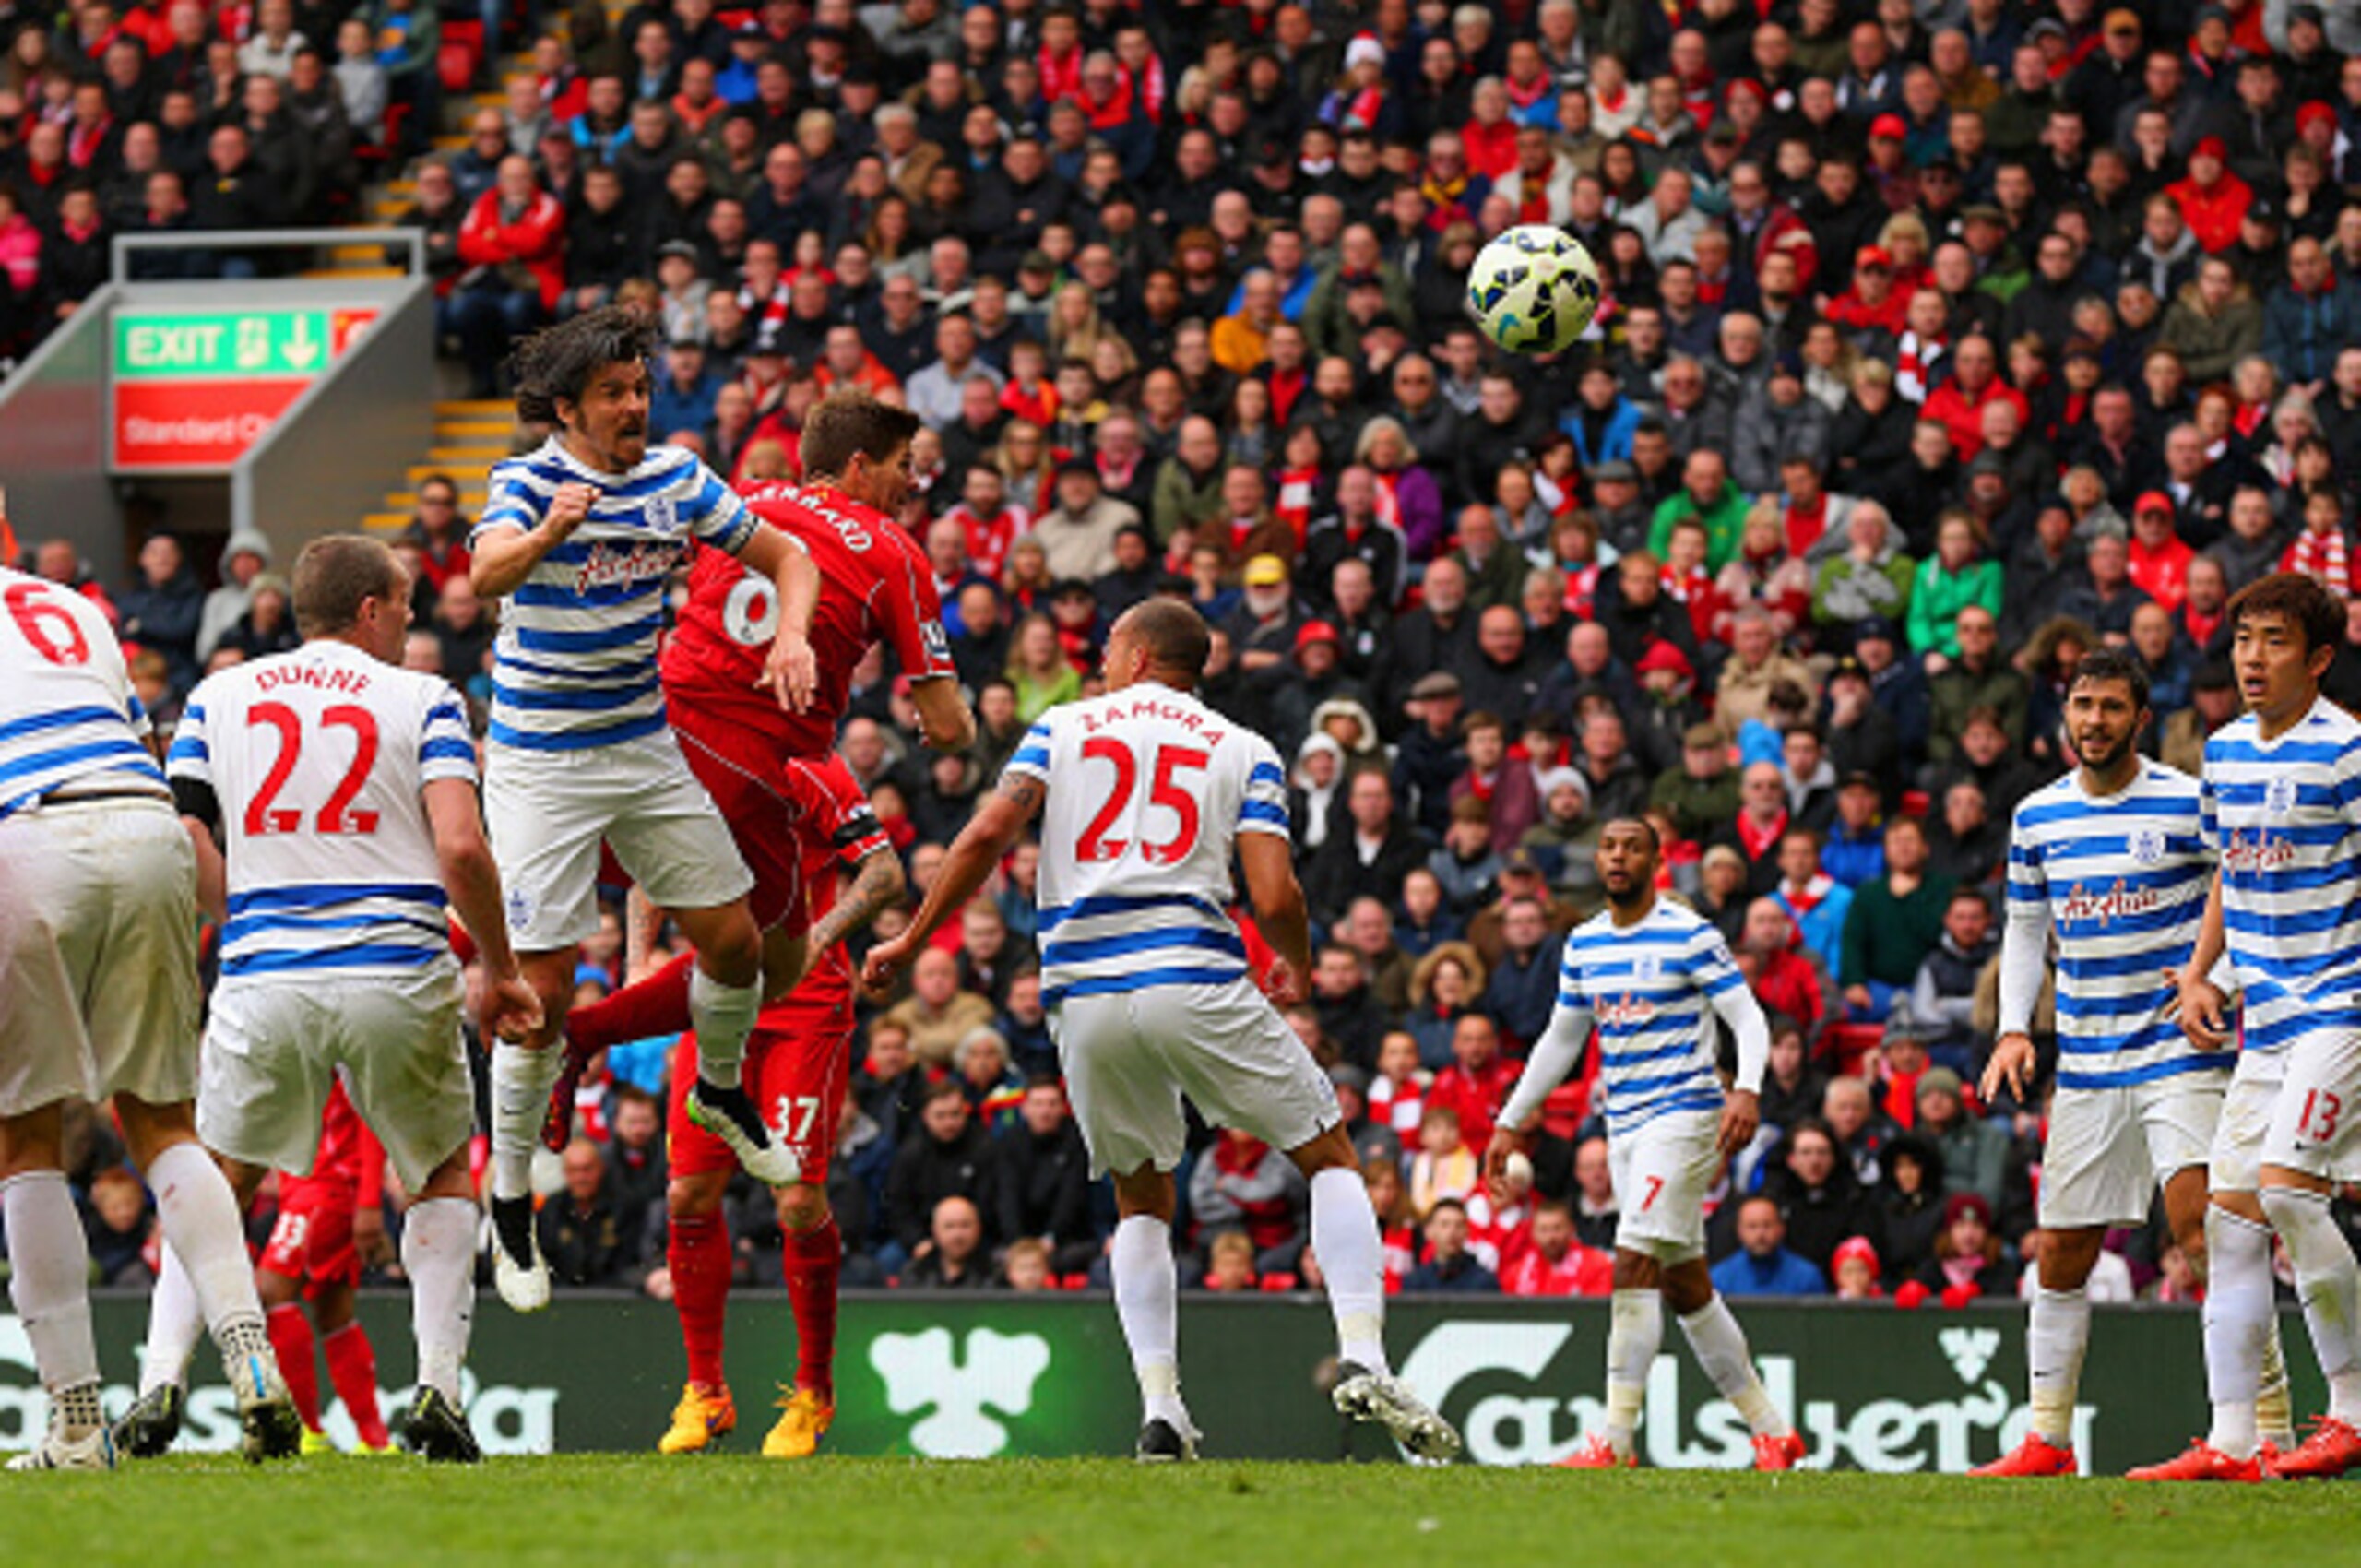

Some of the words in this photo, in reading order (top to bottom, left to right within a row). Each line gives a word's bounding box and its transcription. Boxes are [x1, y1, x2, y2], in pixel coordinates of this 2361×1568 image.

[126, 326, 224, 366] EXIT
[4, 583, 89, 666] 6
[255, 664, 371, 697] DUNNE
[1081, 702, 1225, 746] ZAMORA
[243, 701, 380, 837] 22
[1076, 736, 1210, 864] 25
[777, 1095, 820, 1142] 37
[2295, 1087, 2341, 1142] 13
[1640, 1174, 1664, 1213] 7
